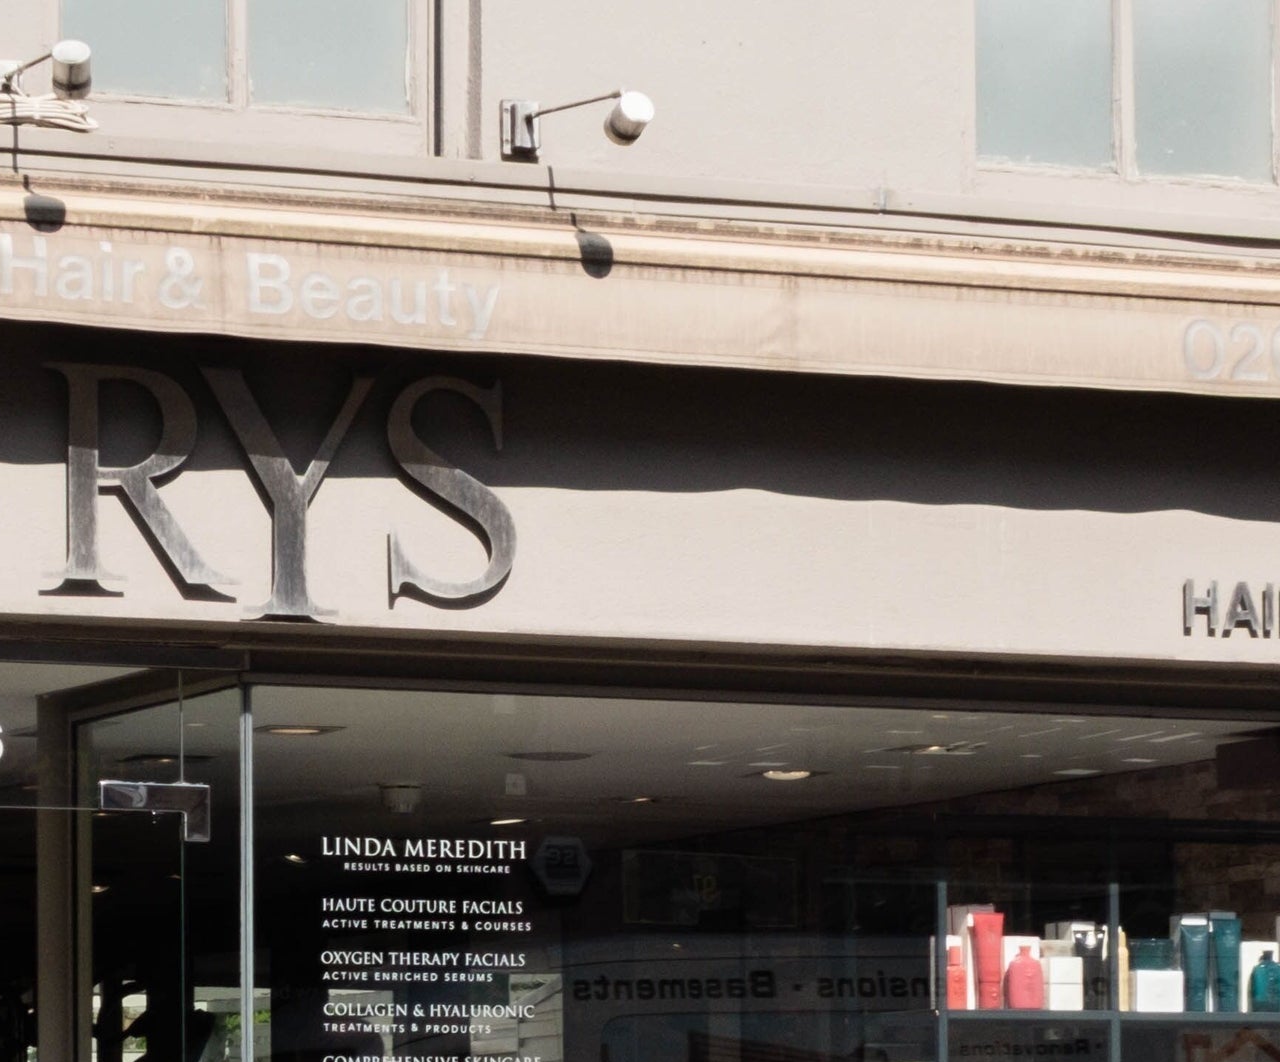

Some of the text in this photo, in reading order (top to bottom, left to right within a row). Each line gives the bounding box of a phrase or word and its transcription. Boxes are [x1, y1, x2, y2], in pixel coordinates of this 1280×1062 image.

[246, 252, 501, 340] Beauty
[38, 361, 518, 620] RYS
[322, 836, 397, 857] LINDA
[404, 839, 526, 860] MEREDITH
[343, 862, 510, 874] RESULTS BASED ON SKINCARE
[322, 897, 523, 915] HAUTE COUTURE FACIALS
[322, 918, 532, 932] ACTIVE TREATMENTS & COURSES
[320, 950, 526, 967] OXYGEN THERAPY FACIALS
[322, 971, 493, 983] ACTIVE ENRICHED SERUMS
[323, 1002, 536, 1019] COLLAGEN & HYALURONIC
[323, 1022, 492, 1034] TREATMENTS & PRODUCTS
